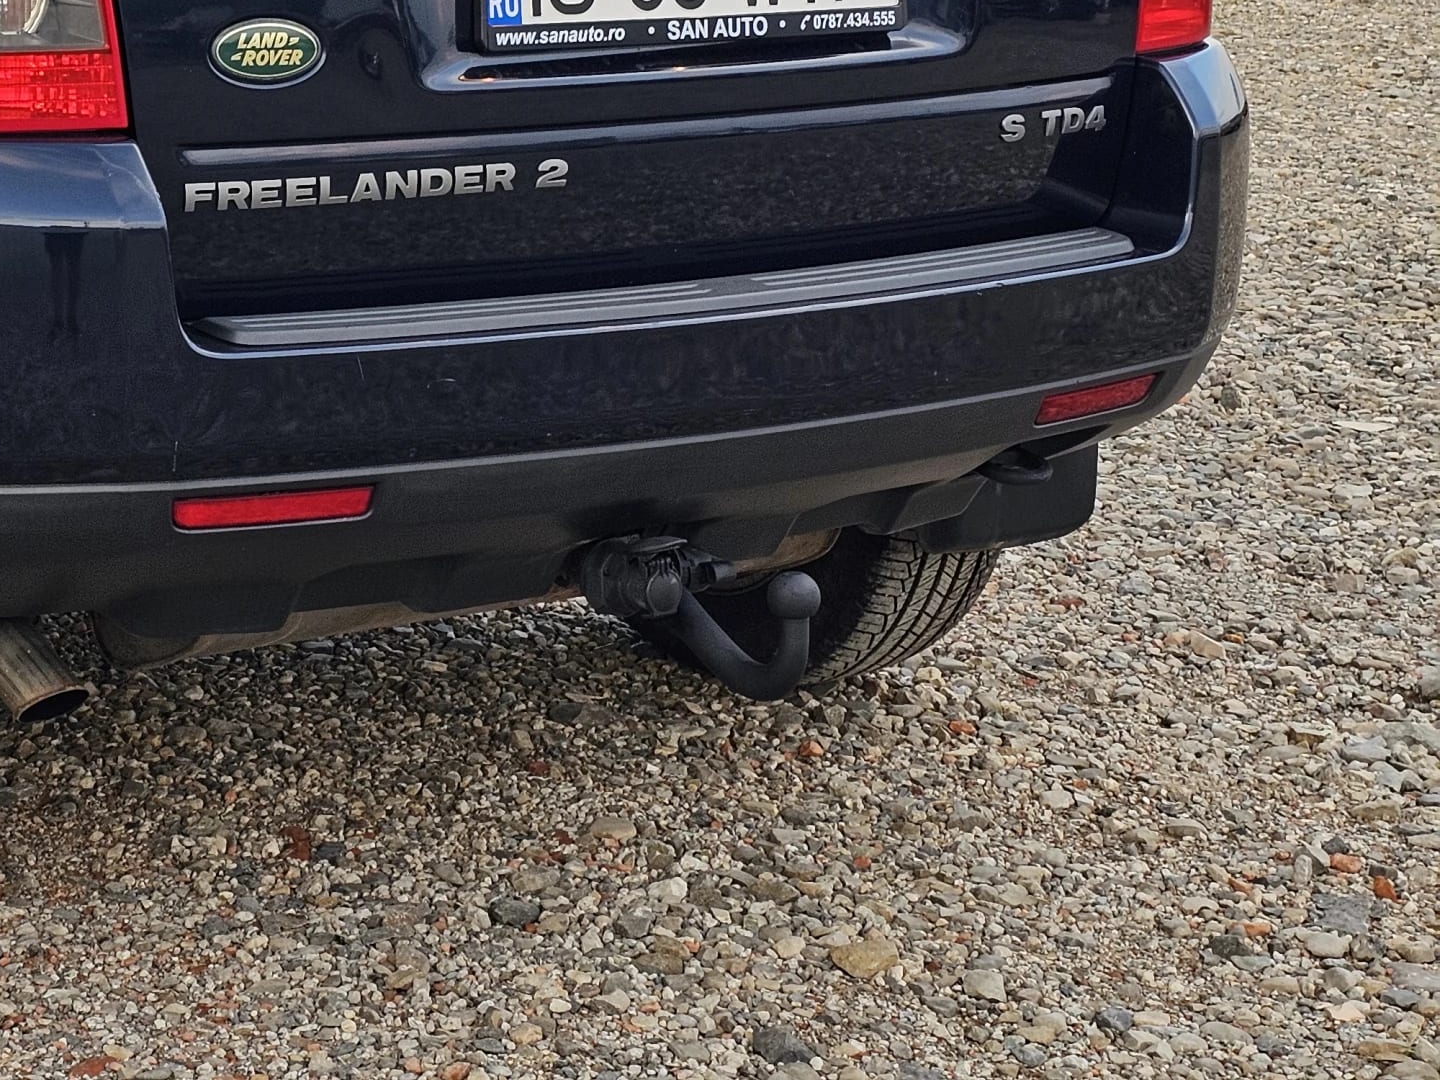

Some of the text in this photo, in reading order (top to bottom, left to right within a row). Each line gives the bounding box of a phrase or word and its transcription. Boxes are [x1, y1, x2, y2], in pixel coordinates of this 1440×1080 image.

[237, 32, 289, 50] LAND
[495, 10, 896, 46] www.sanauto.ro SAN AUTO 0787.434.555
[241, 49, 304, 67] ROVER
[1000, 104, 1107, 142] S TD4
[184, 158, 569, 213] FREELANDER 2
